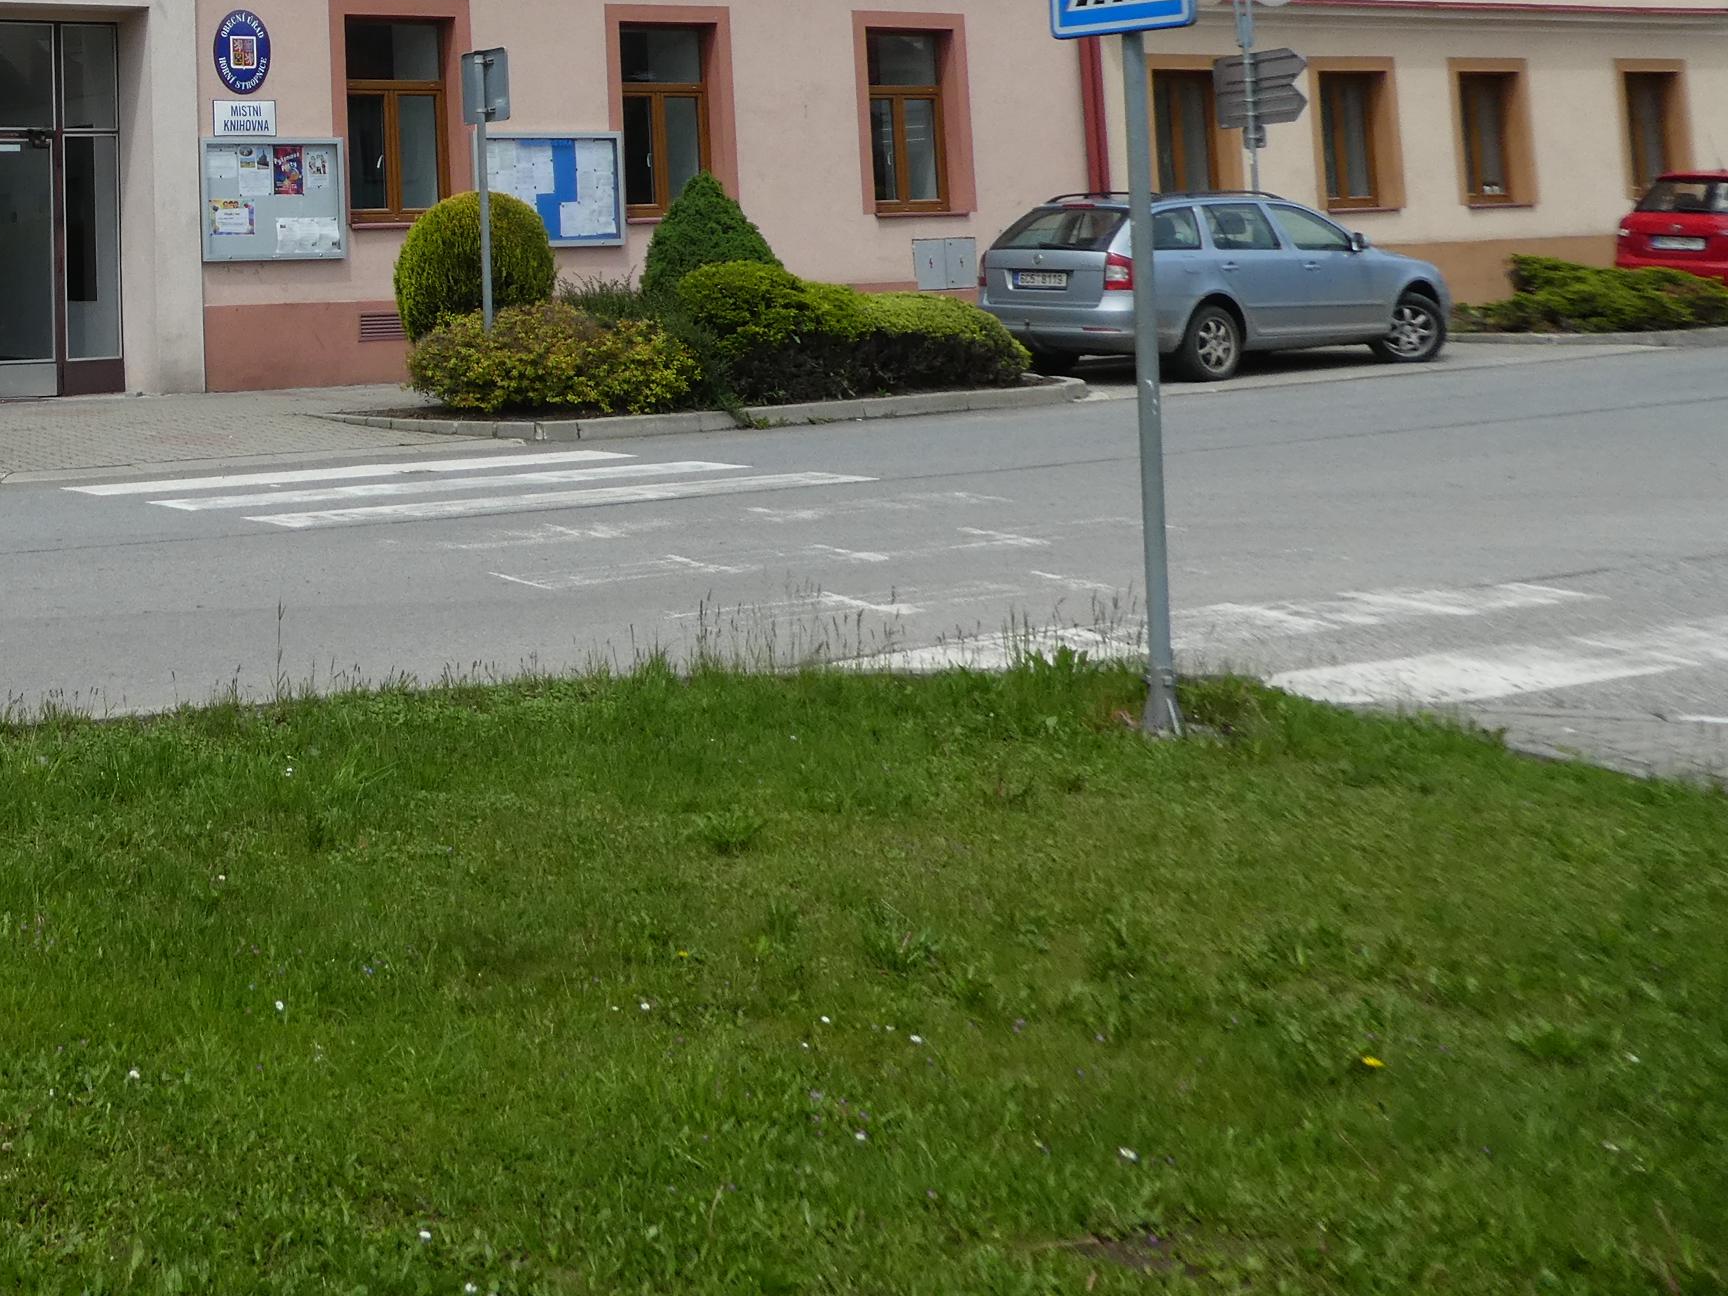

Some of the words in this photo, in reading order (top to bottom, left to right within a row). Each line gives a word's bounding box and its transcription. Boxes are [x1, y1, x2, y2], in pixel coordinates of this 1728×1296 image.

[220, 12, 246, 39] OBECNÍ
[246, 15, 265, 39] ÚŘAD
[218, 56, 237, 84] HORNÍ
[235, 57, 268, 90] STROPNICE
[230, 104, 262, 117] MÍSTNÍ
[223, 119, 270, 132] KNIHOVNA
